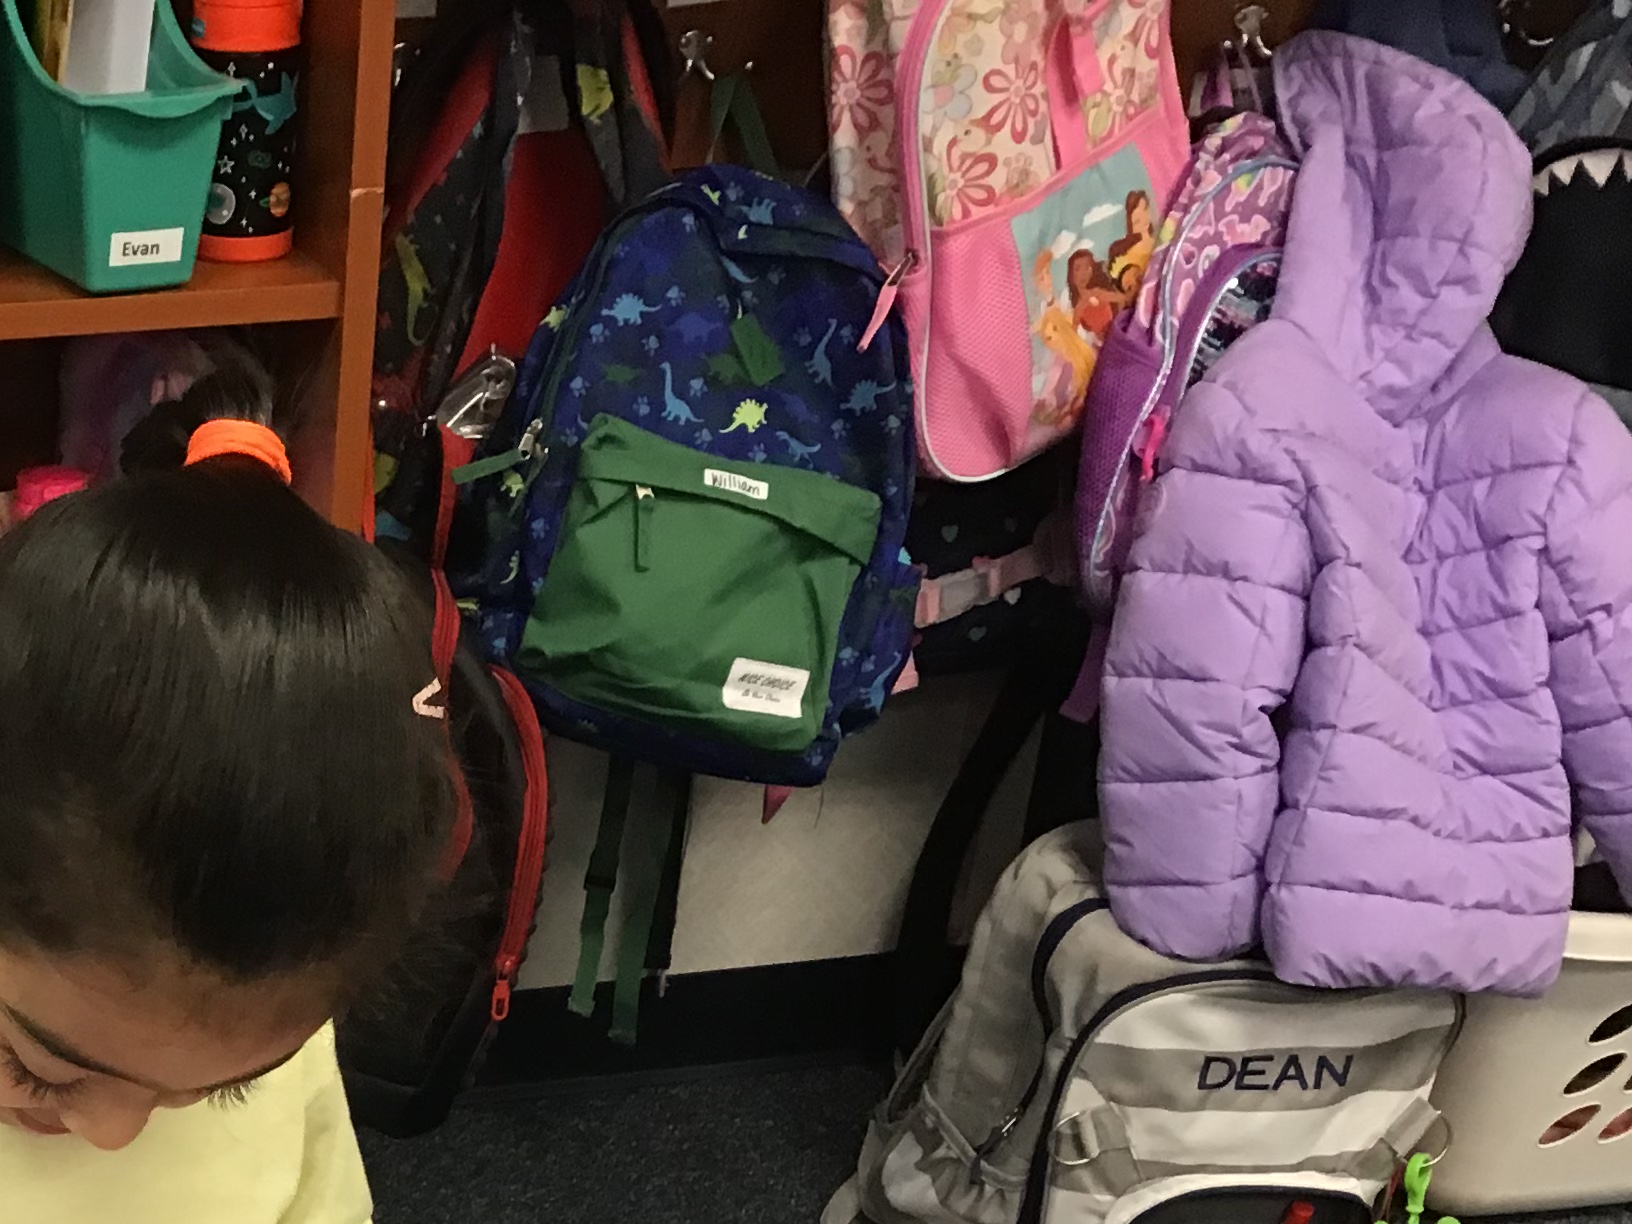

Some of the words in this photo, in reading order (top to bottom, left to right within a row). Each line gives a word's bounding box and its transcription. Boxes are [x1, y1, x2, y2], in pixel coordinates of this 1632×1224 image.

[121, 241, 161, 257] Evan
[711, 472, 761, 496] William
[1197, 1053, 1354, 1091] DEAN
